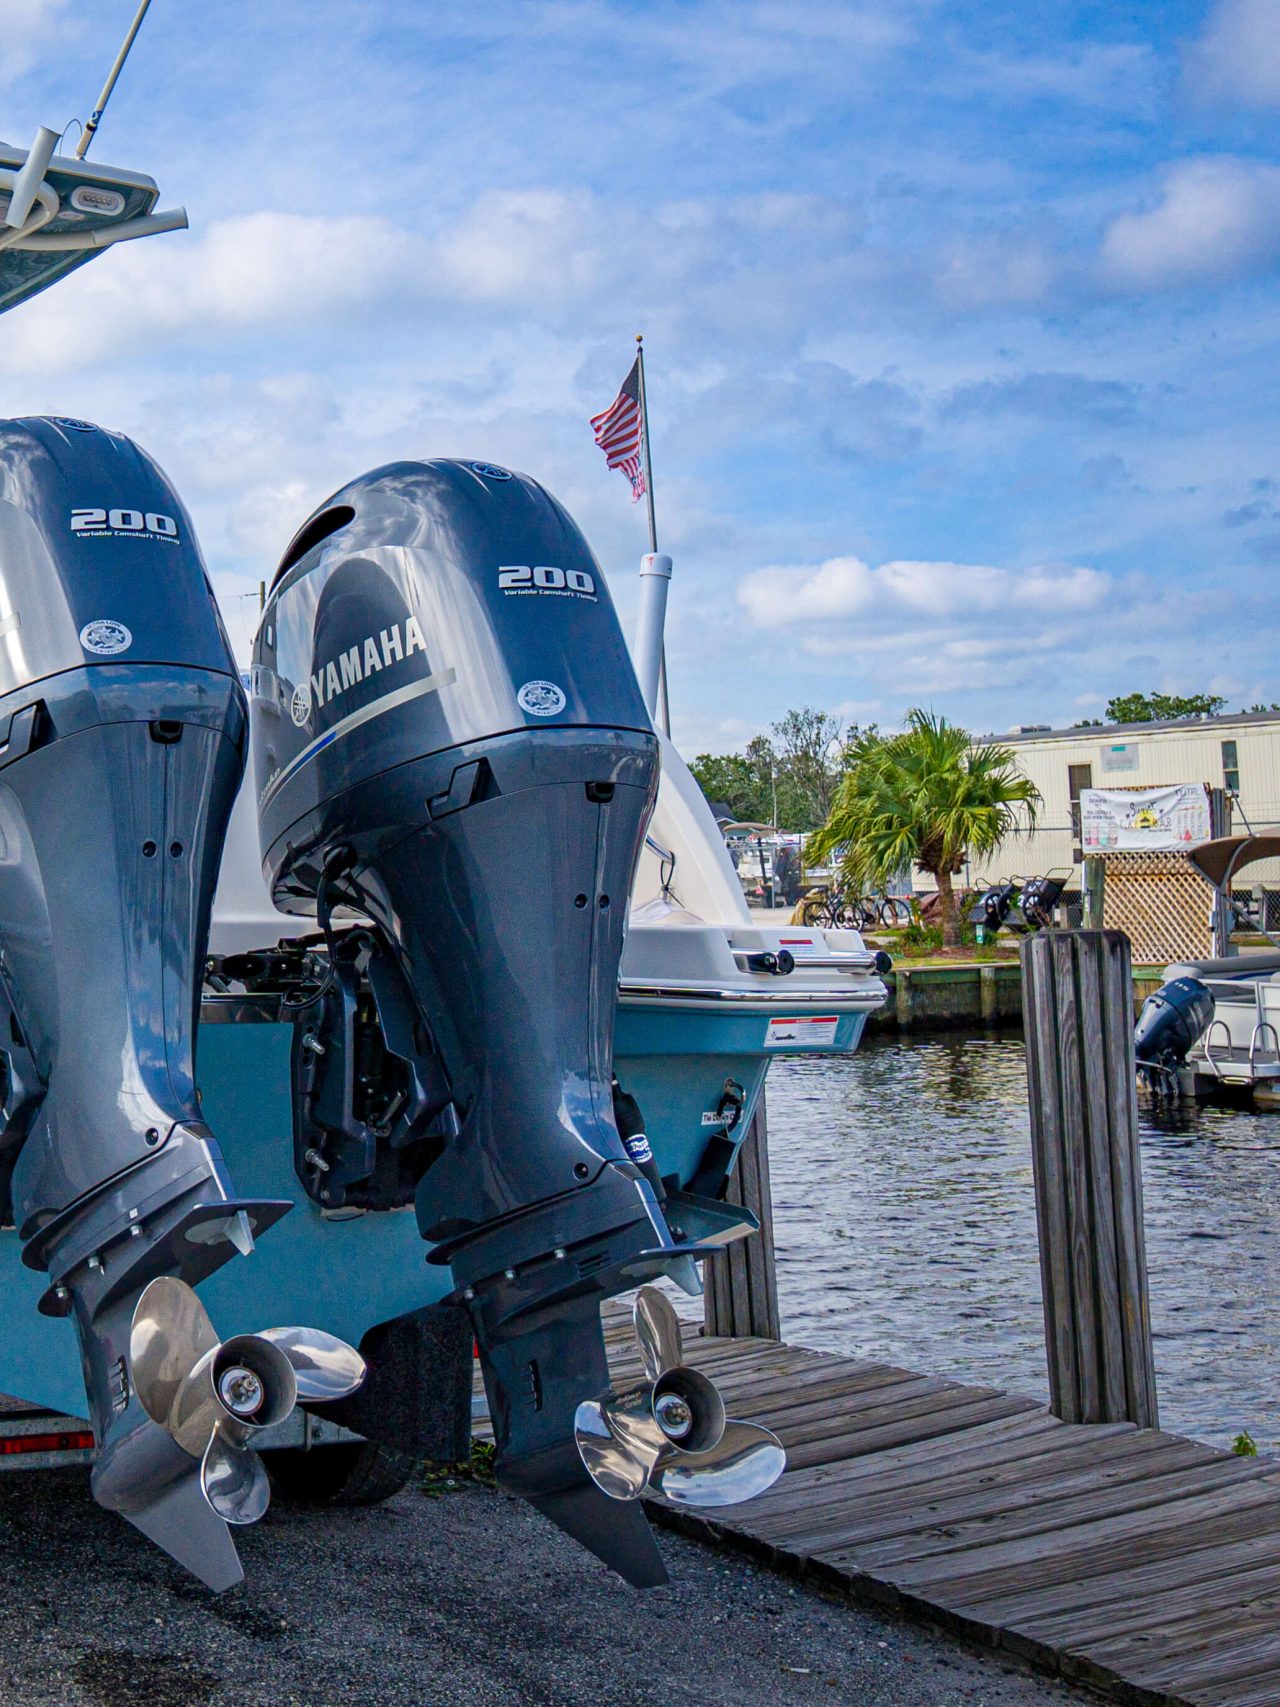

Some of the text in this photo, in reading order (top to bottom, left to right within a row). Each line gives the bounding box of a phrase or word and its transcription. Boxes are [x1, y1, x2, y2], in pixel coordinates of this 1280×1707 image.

[71, 508, 177, 536] 200
[114, 530, 154, 539] Camshaft
[499, 565, 595, 593] 200
[310, 615, 427, 708] YAMAHA
